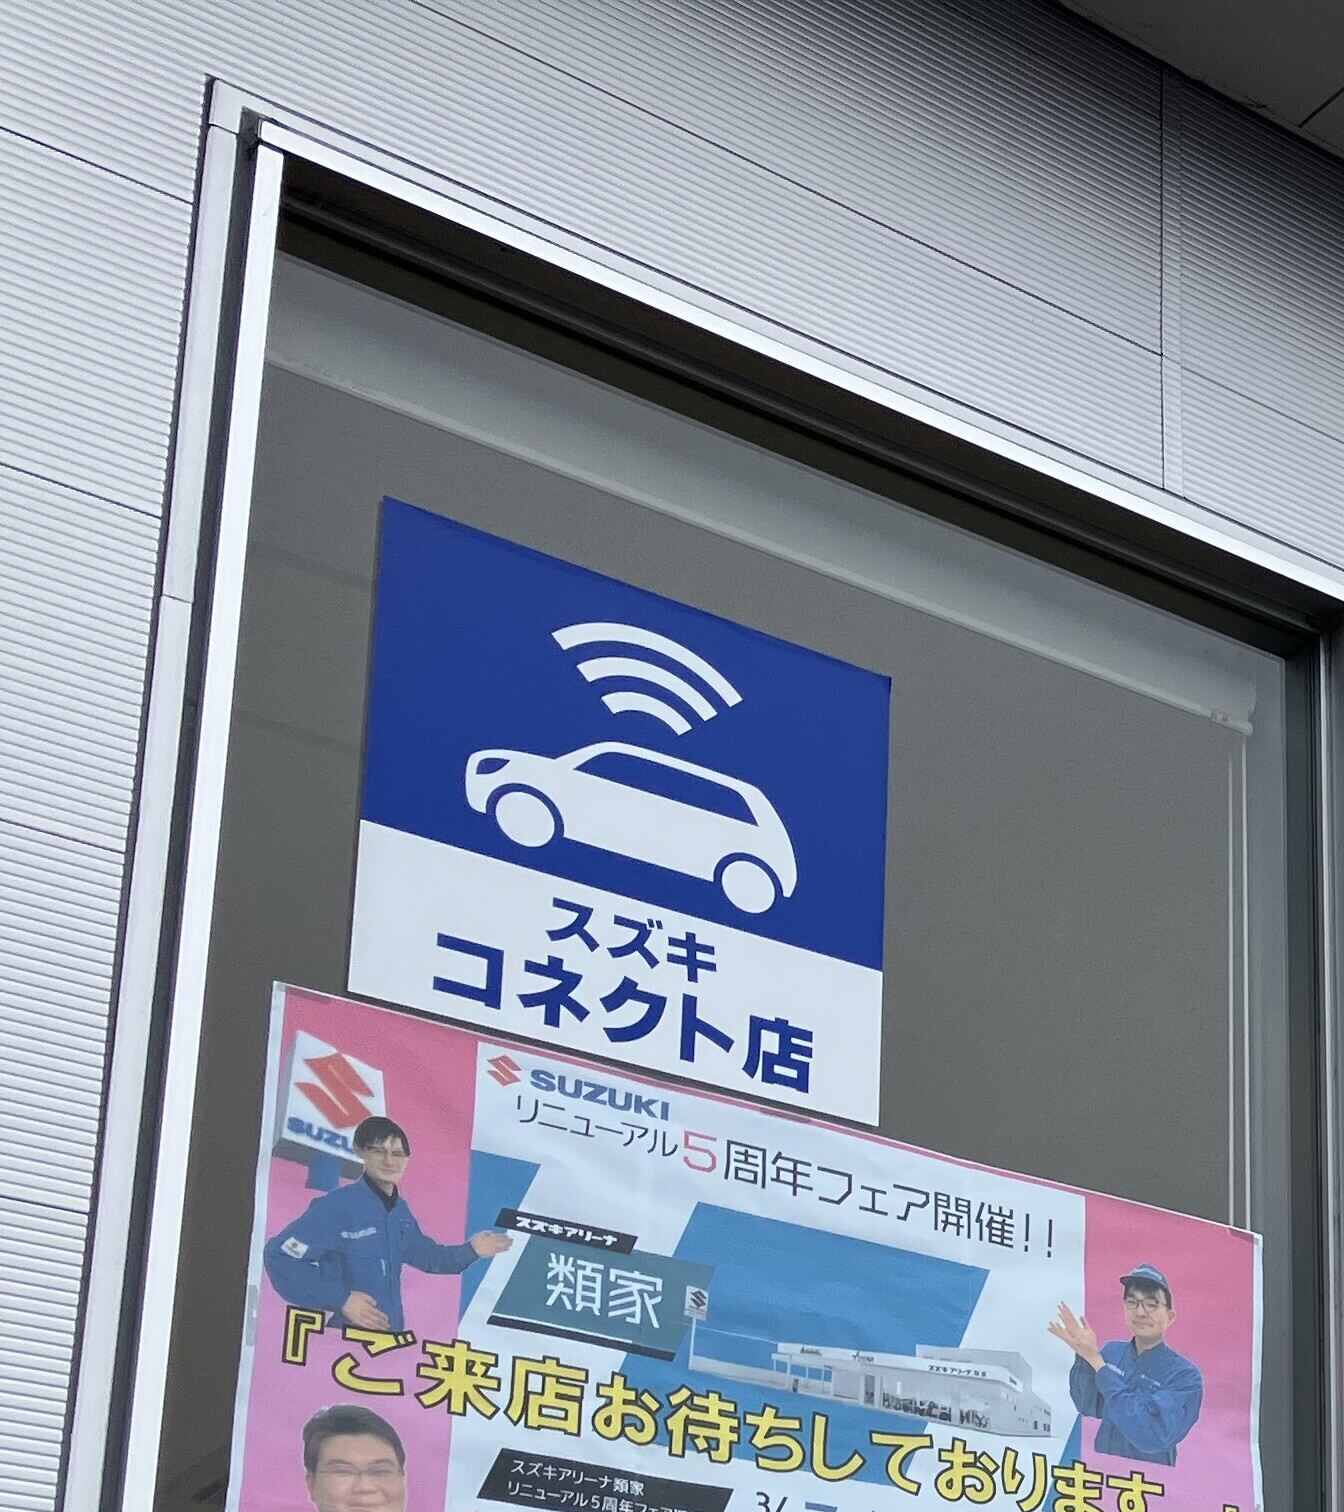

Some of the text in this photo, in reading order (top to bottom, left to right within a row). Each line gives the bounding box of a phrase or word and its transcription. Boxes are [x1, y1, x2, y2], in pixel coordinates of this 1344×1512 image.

[545, 896, 718, 984] スズキ
[433, 932, 814, 1094] コネクト店
[530, 1068, 670, 1122] SUZUKI
[515, 1215, 619, 1248] スズキアリーナ
[545, 1252, 663, 1330] 類家
[509, 1458, 646, 1498] スズキアリーナ類家
